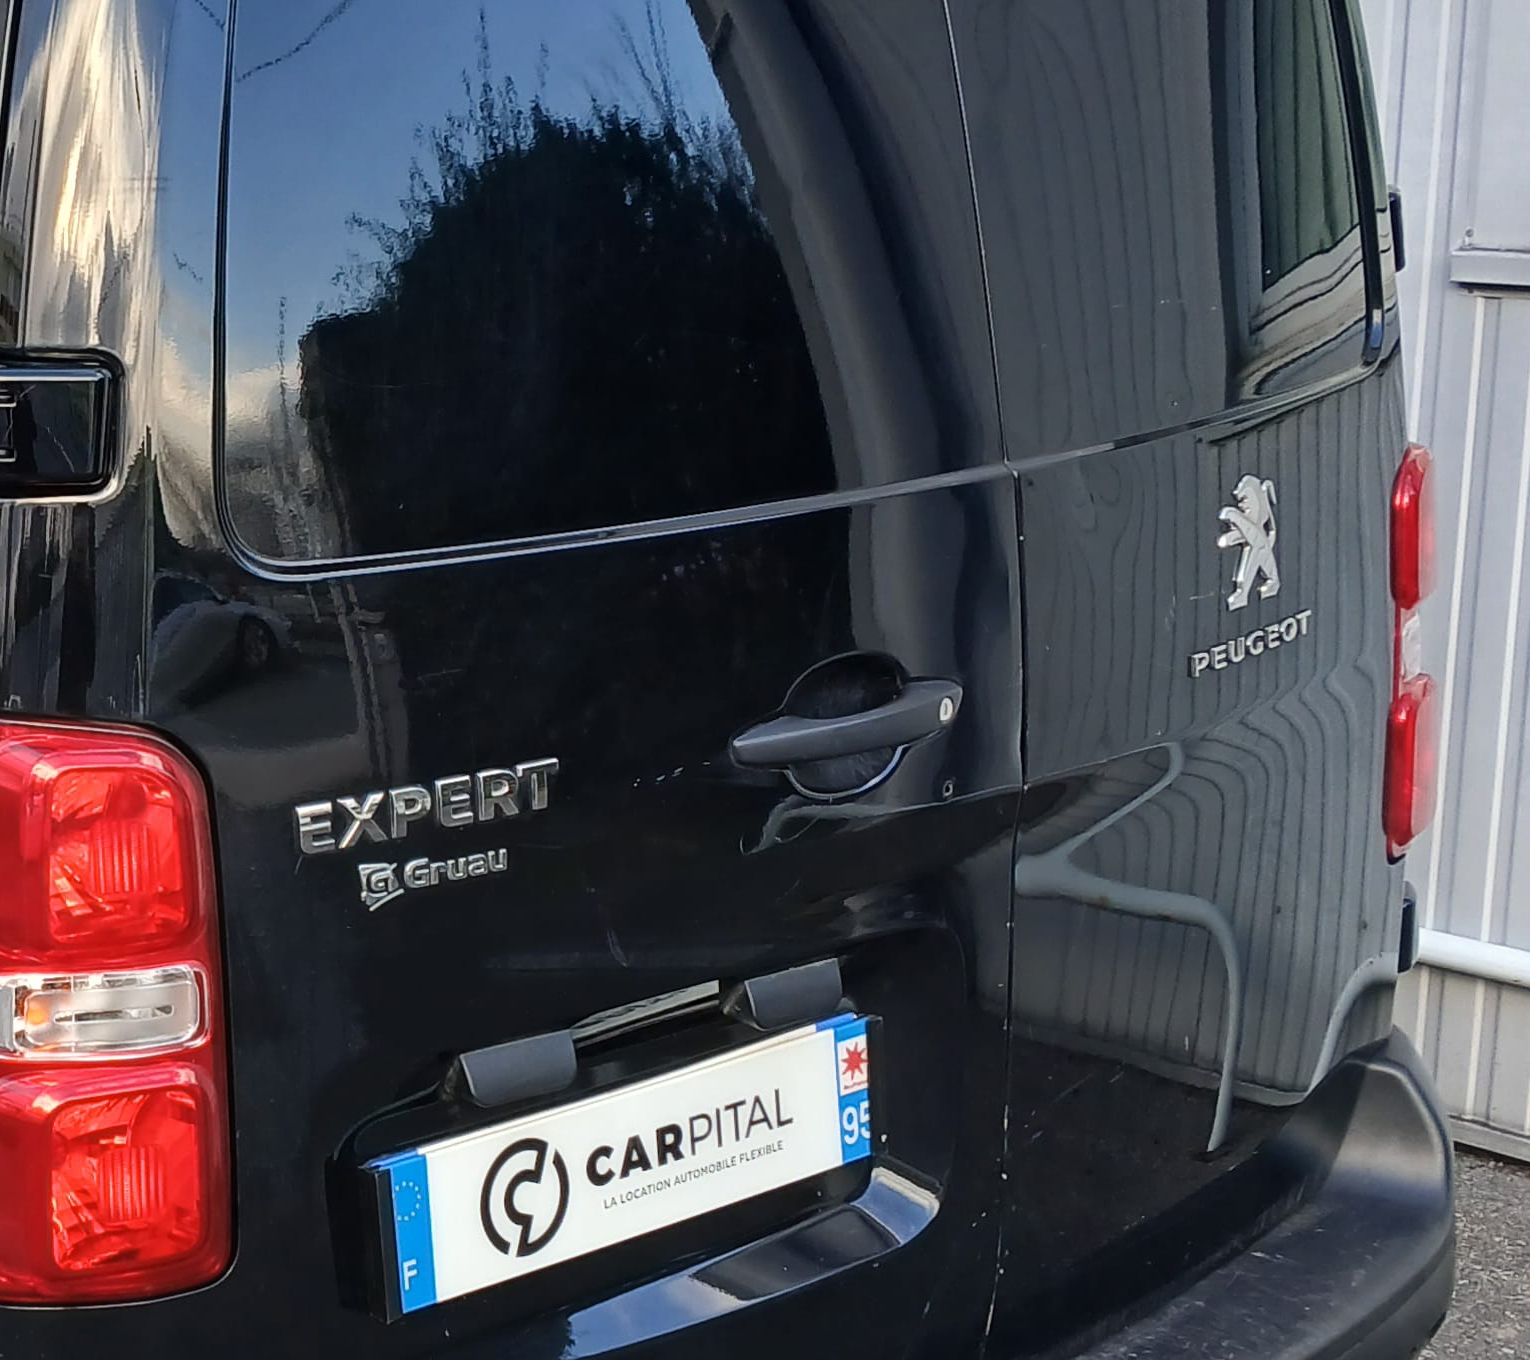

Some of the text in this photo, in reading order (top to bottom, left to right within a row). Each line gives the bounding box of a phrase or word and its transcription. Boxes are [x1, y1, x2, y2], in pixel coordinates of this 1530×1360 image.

[1188, 609, 1312, 678] PEUGEOT
[294, 757, 559, 855] EXPERT
[404, 848, 508, 889] Gruau
[586, 1088, 794, 1186] CARPITAL
[842, 1100, 871, 1145] 95
[603, 1141, 784, 1209] LA LOCATION AUTOMOBILE FLEXIBLE
[401, 1259, 418, 1291] F
